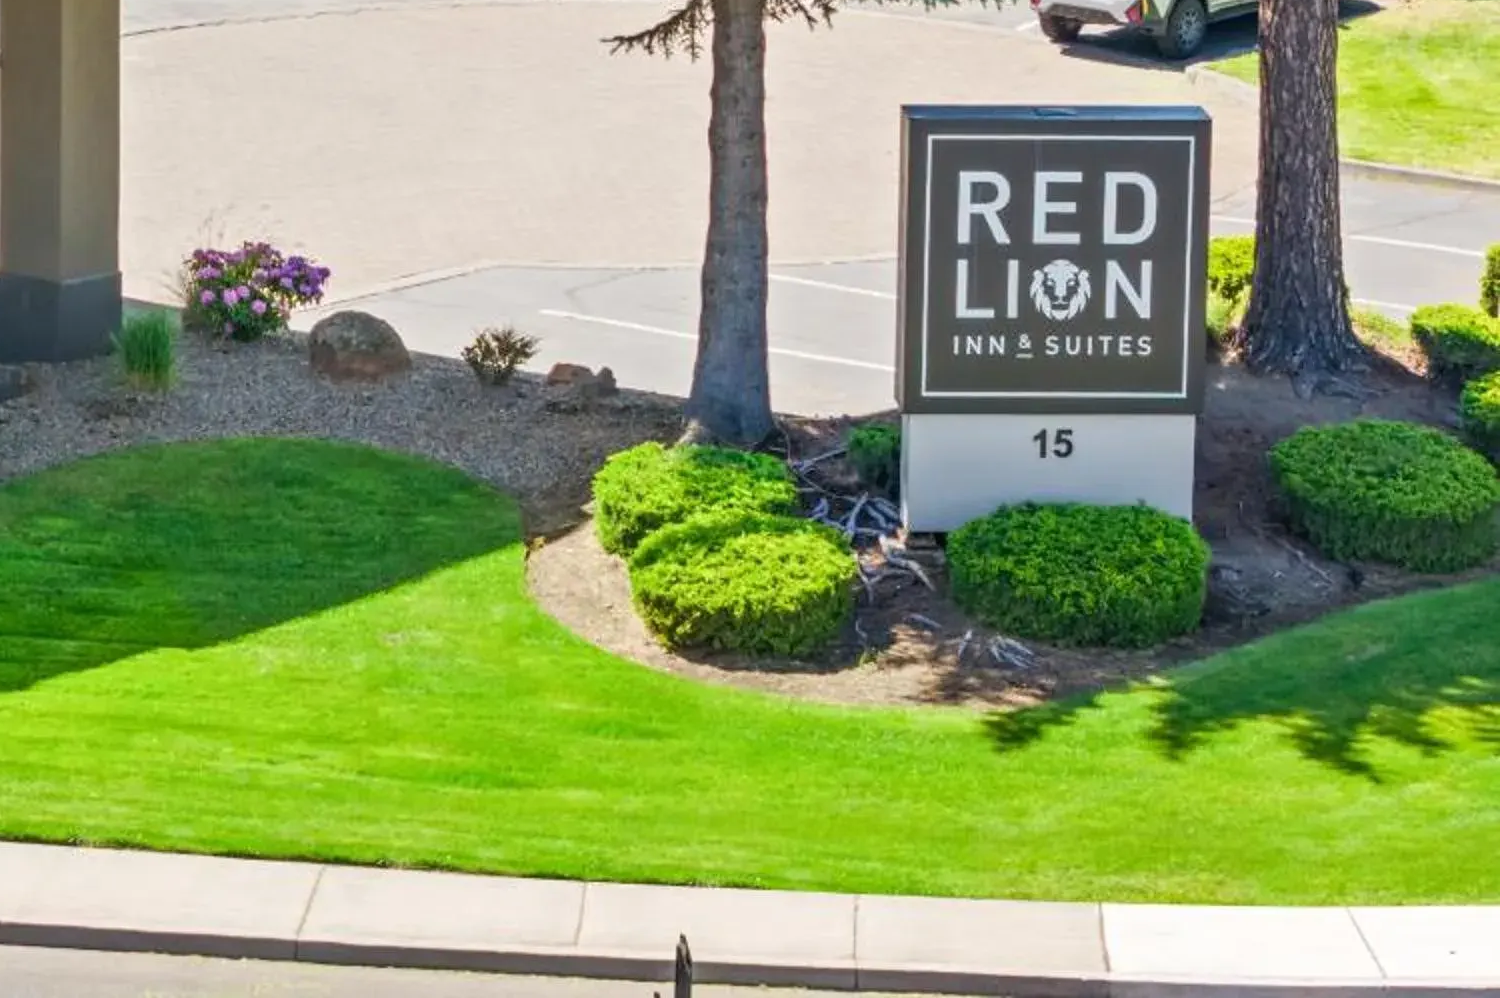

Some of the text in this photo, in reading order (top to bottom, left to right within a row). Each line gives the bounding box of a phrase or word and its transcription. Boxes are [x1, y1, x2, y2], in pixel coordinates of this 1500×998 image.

[956, 170, 1159, 245] RED
[953, 333, 1153, 359] INN & SUITES
[1032, 428, 1074, 459] 15
